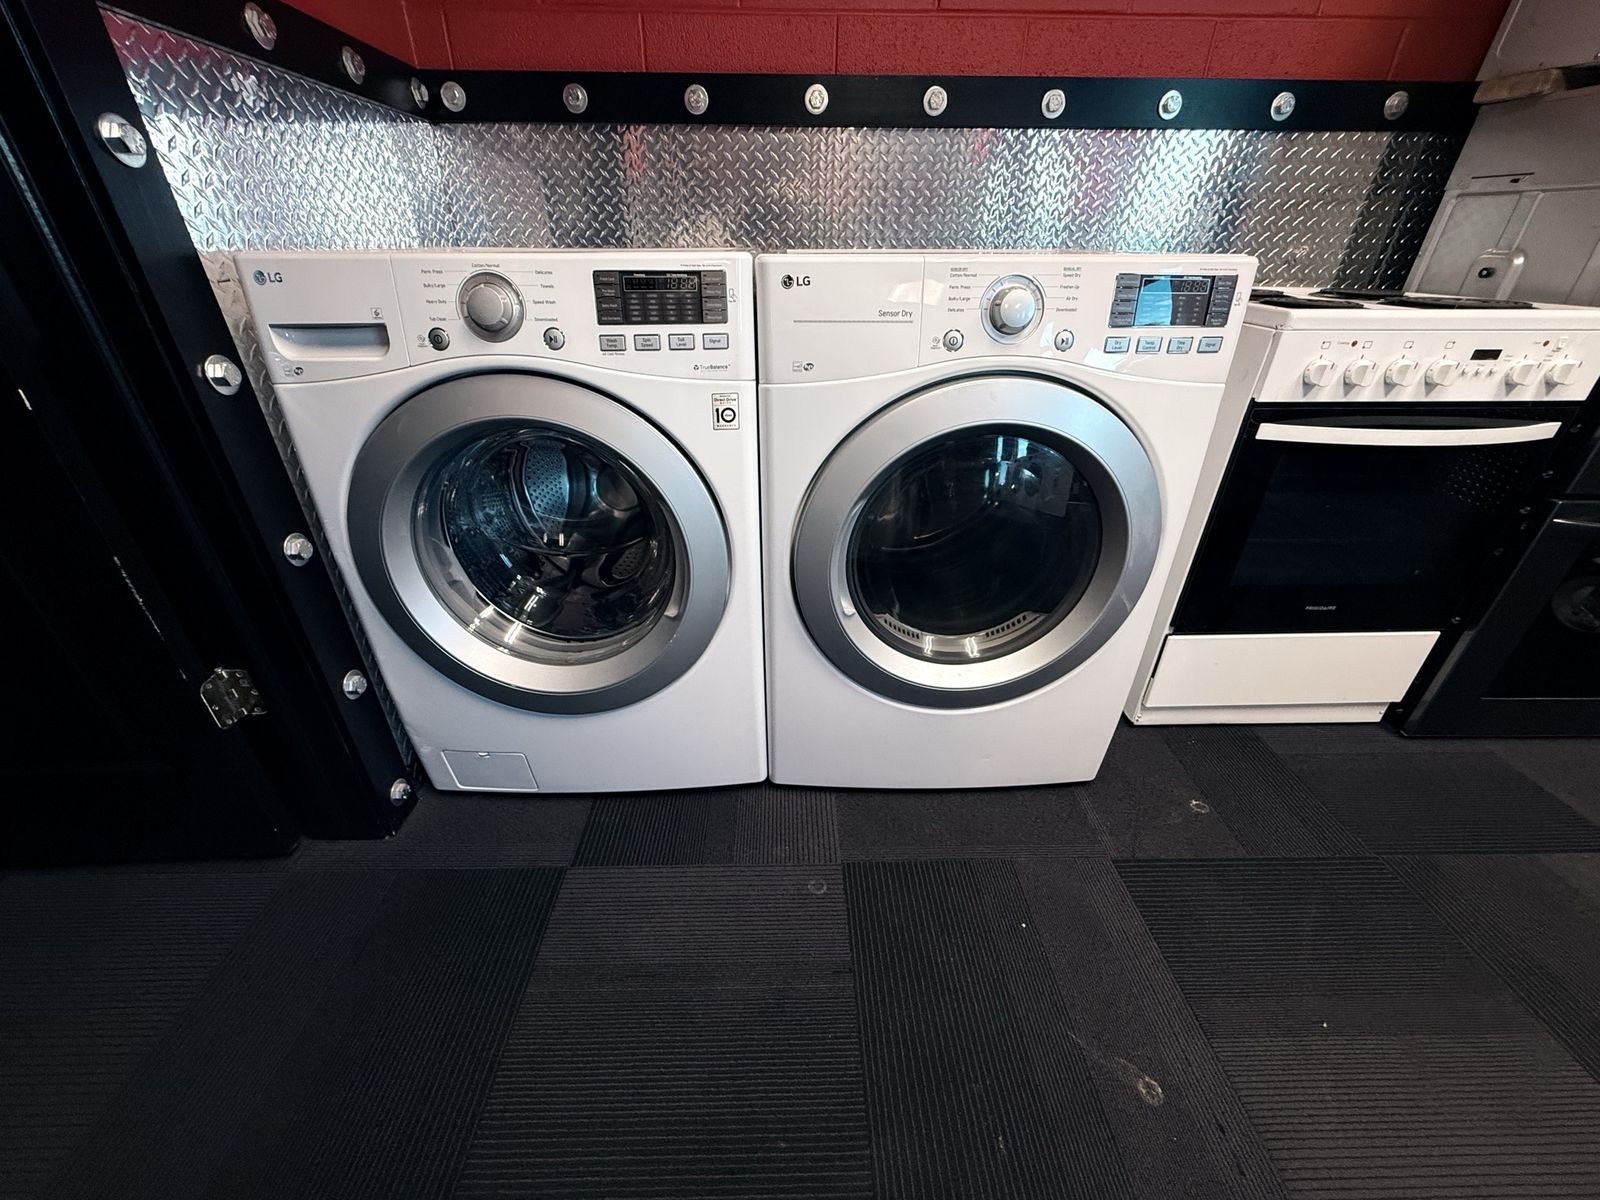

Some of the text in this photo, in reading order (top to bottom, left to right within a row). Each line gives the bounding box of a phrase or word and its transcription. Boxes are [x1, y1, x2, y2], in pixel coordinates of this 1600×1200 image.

[268, 272, 283, 283] LG
[796, 276, 811, 287] LG
[878, 309, 913, 318] Sensor Dry
[715, 407, 737, 423] 10
